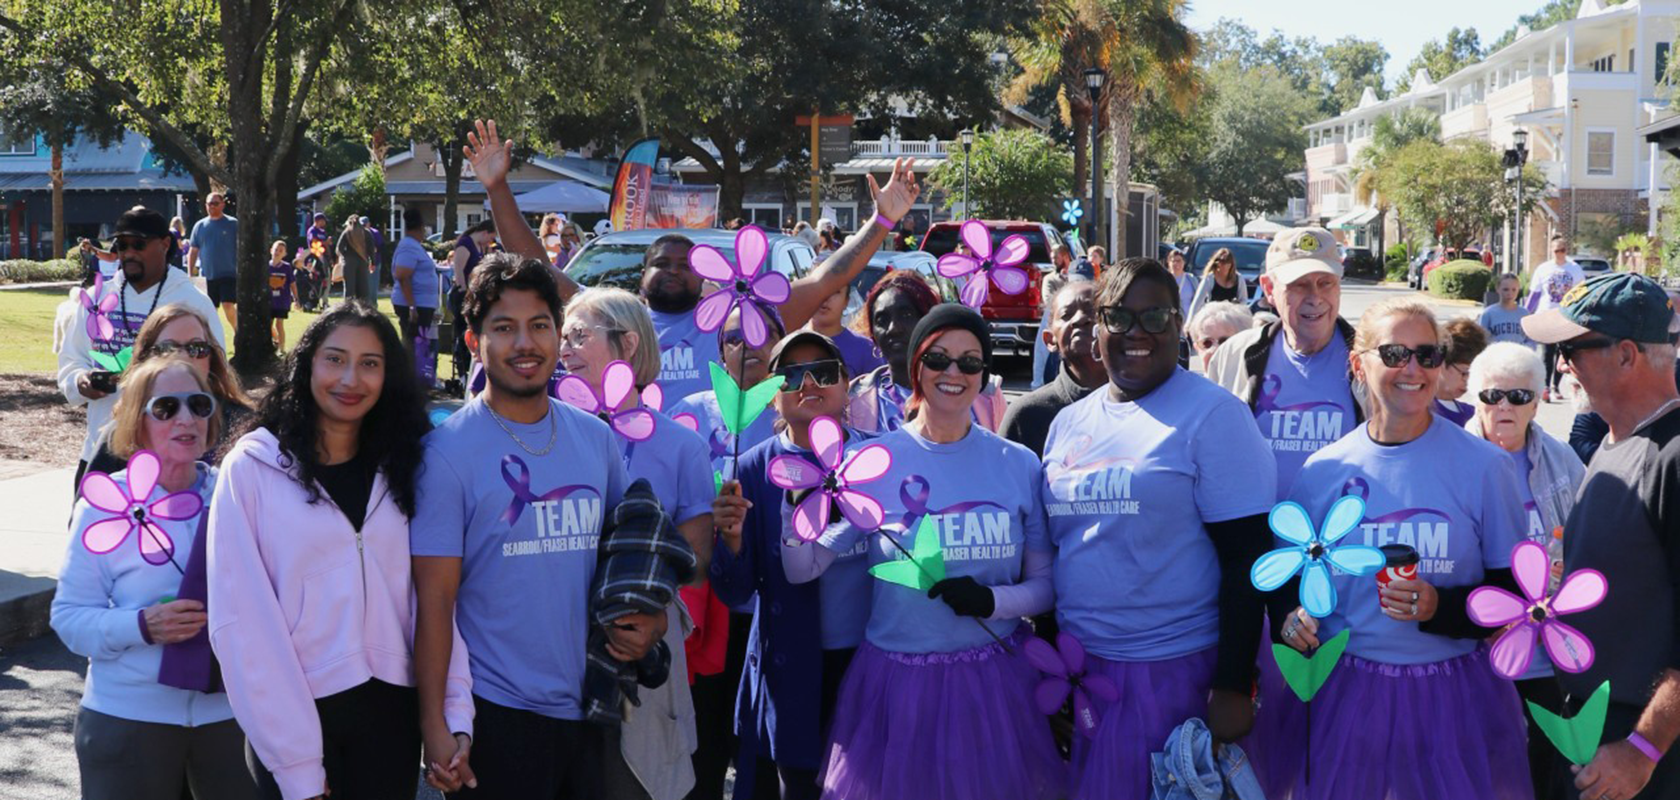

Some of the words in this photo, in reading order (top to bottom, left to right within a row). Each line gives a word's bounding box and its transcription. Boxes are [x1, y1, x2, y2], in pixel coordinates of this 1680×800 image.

[623, 173, 638, 231] BROOK
[660, 347, 694, 371] AM
[1270, 410, 1343, 440] TEAM
[1068, 465, 1134, 501] TEAM
[532, 498, 600, 538] TEAM
[1099, 501, 1119, 515] HEALTH
[1120, 500, 1140, 515] CARE
[929, 512, 1011, 546] TEAM
[1360, 522, 1449, 558] TEAM
[972, 544, 1000, 560] HEALTH
